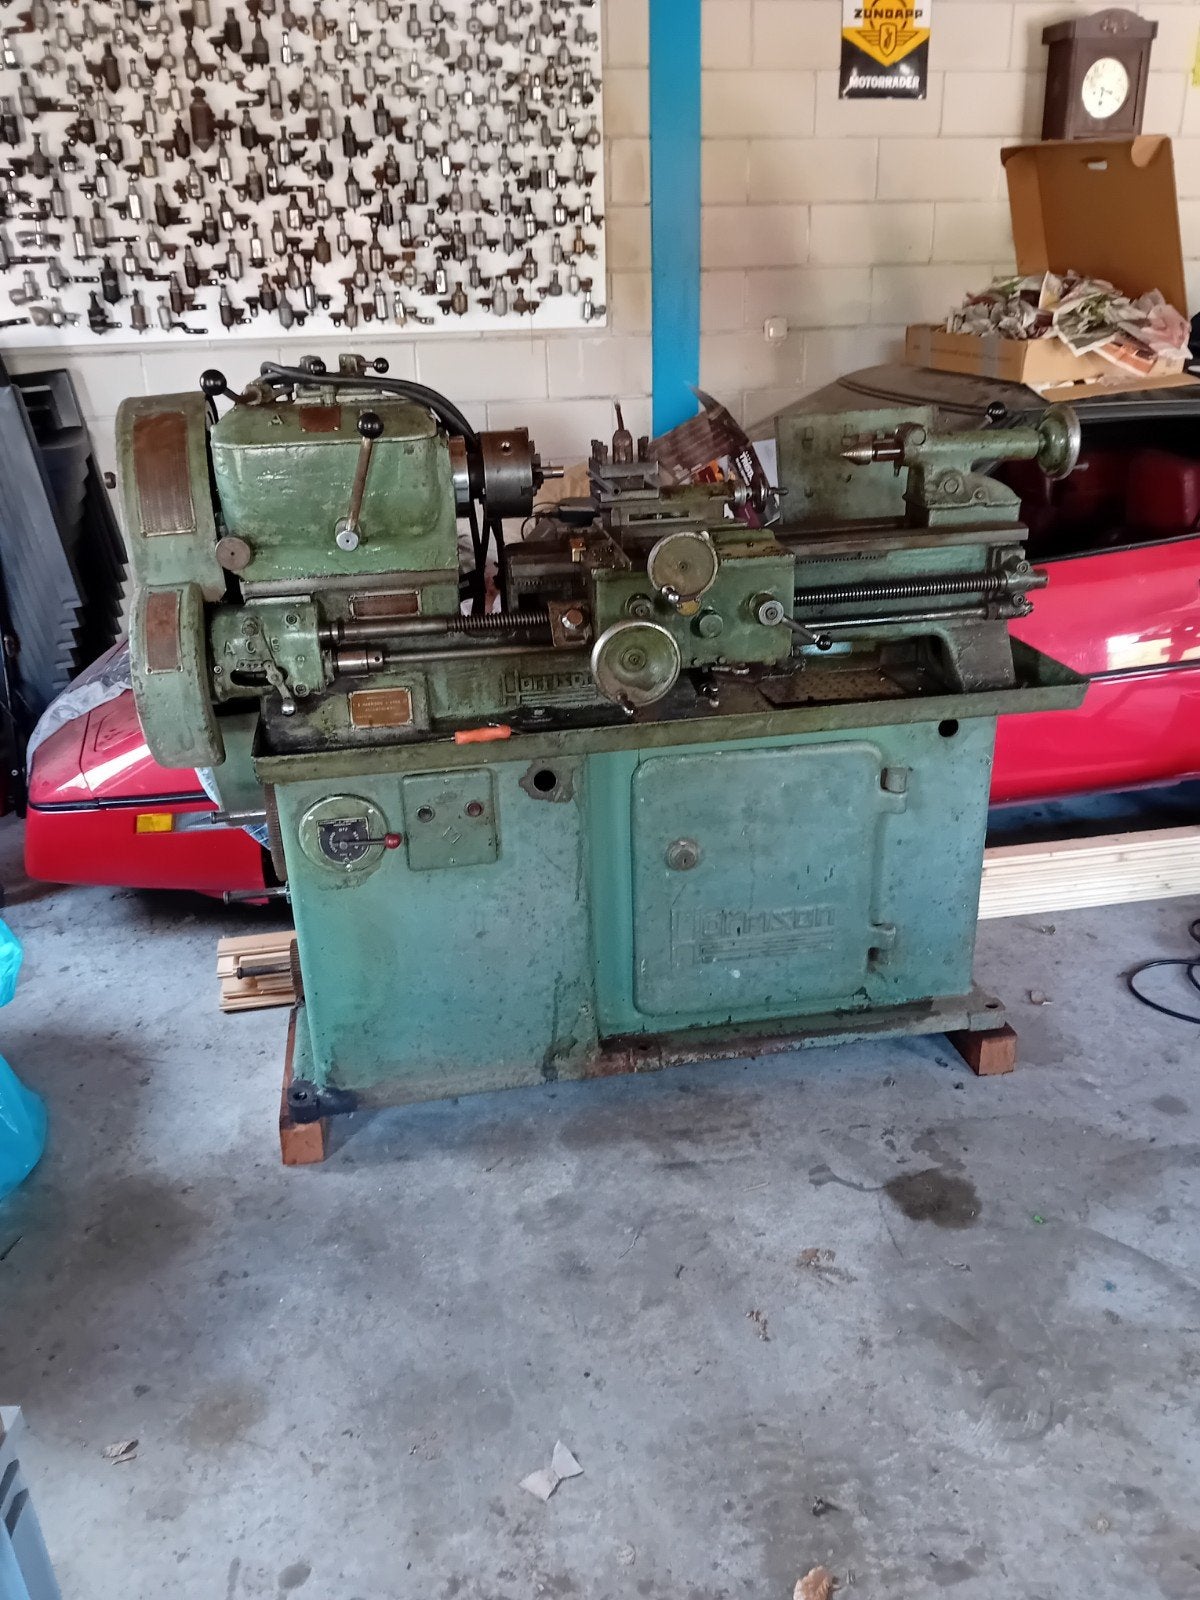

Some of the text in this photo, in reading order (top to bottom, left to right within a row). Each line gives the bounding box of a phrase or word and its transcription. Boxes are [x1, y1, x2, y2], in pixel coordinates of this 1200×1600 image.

[224, 637, 280, 656] A C B
